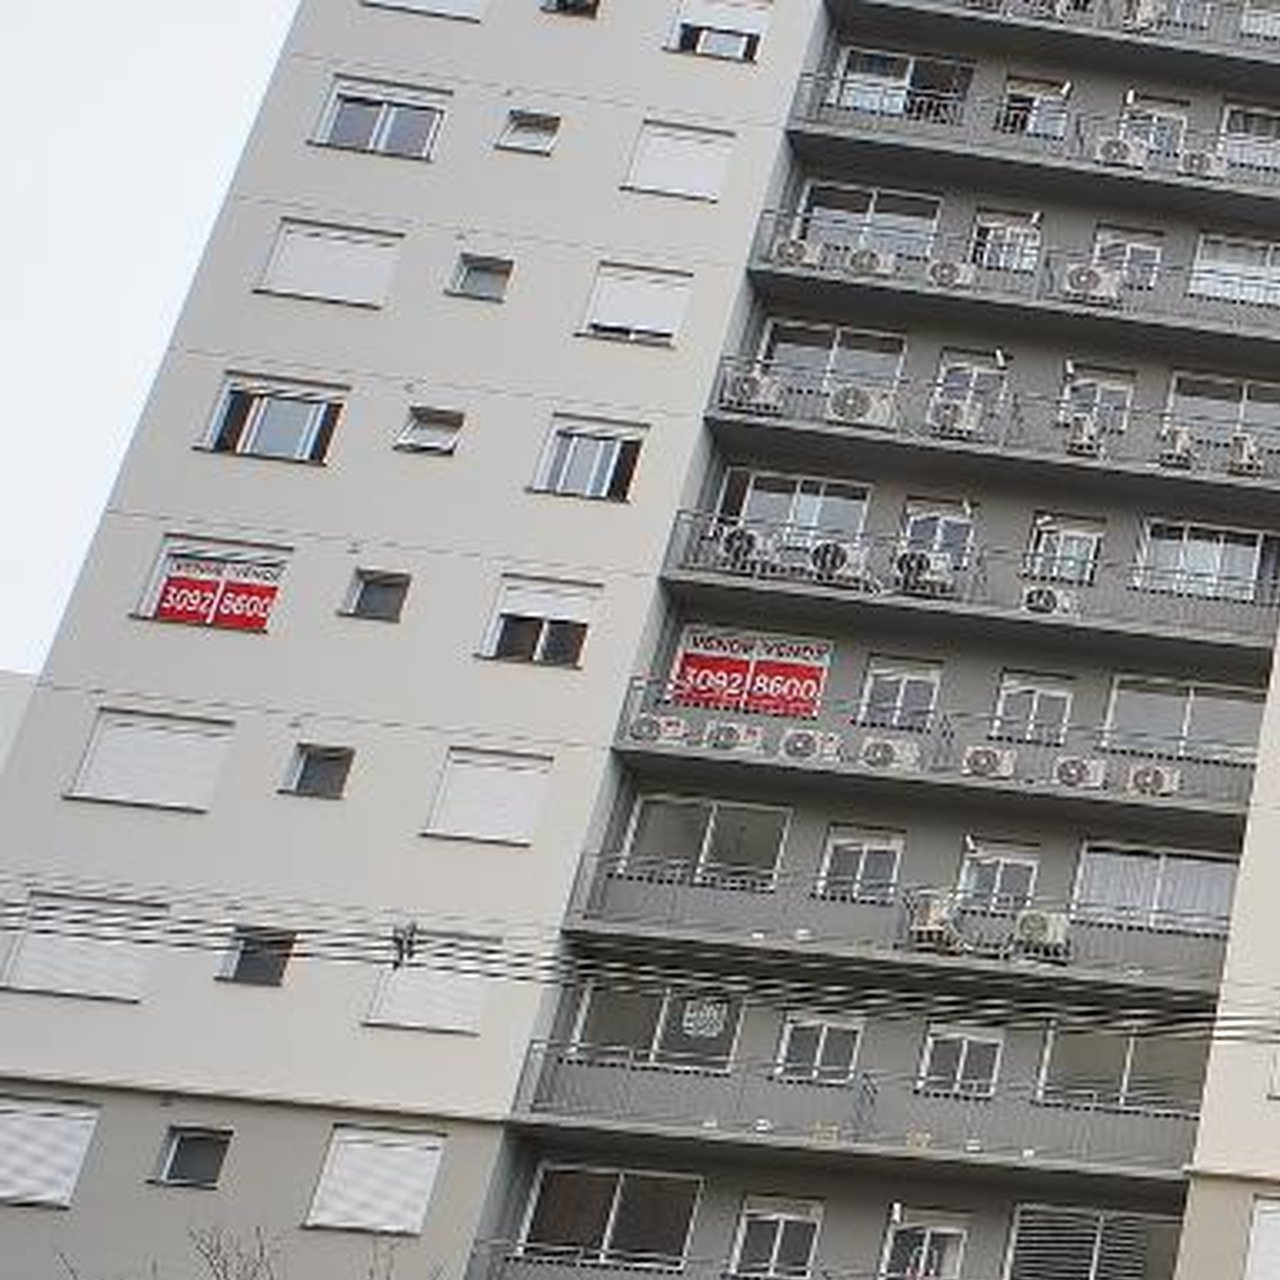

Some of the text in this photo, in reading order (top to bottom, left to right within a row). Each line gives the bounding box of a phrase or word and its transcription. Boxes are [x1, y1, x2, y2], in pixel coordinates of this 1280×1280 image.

[162, 586, 214, 614] 3092
[683, 666, 818, 699] 3092 8600
